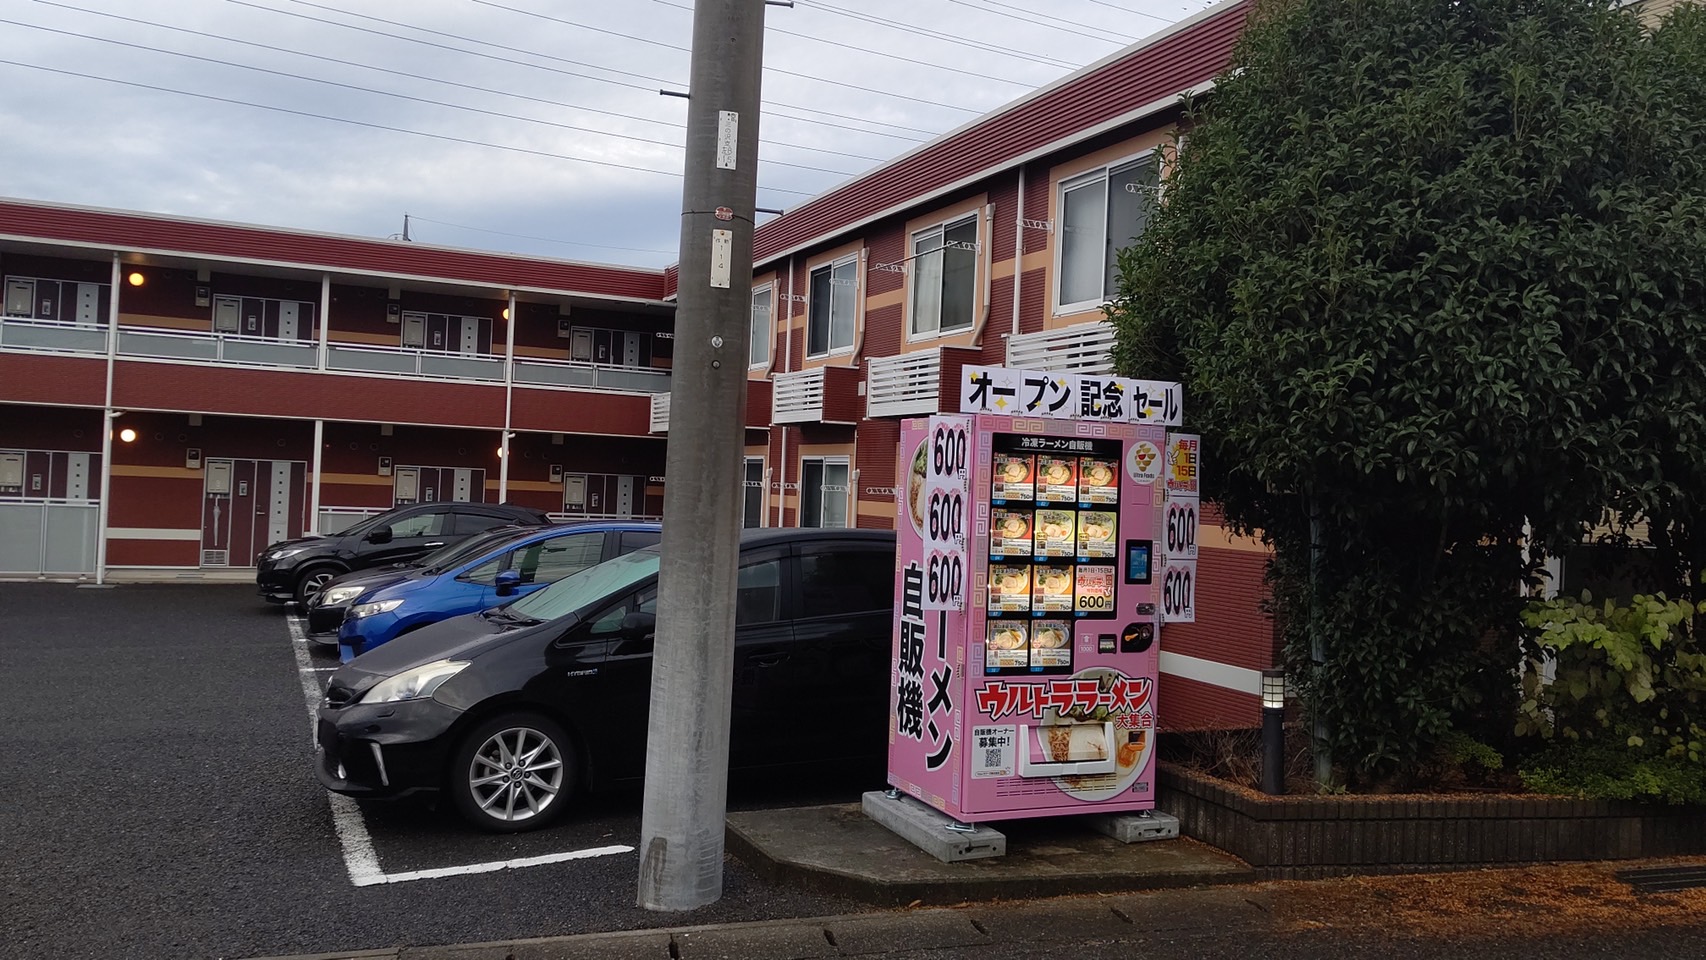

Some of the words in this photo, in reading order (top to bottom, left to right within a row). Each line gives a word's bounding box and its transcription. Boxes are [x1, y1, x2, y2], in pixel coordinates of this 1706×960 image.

[1021, 437, 1093, 451] 冷凍ラーメン自販機
[1178, 439, 1198, 451] 毎月
[1183, 452, 1197, 464] 1日
[1176, 465, 1197, 477] 15日
[1079, 595, 1112, 609] 600円
[897, 562, 926, 741] 自販機
[974, 673, 1153, 723] ウルトララーメン
[1115, 711, 1153, 729] 大集合
[974, 728, 1015, 736] 自販機オーナー
[978, 736, 1010, 748] 募集中!
